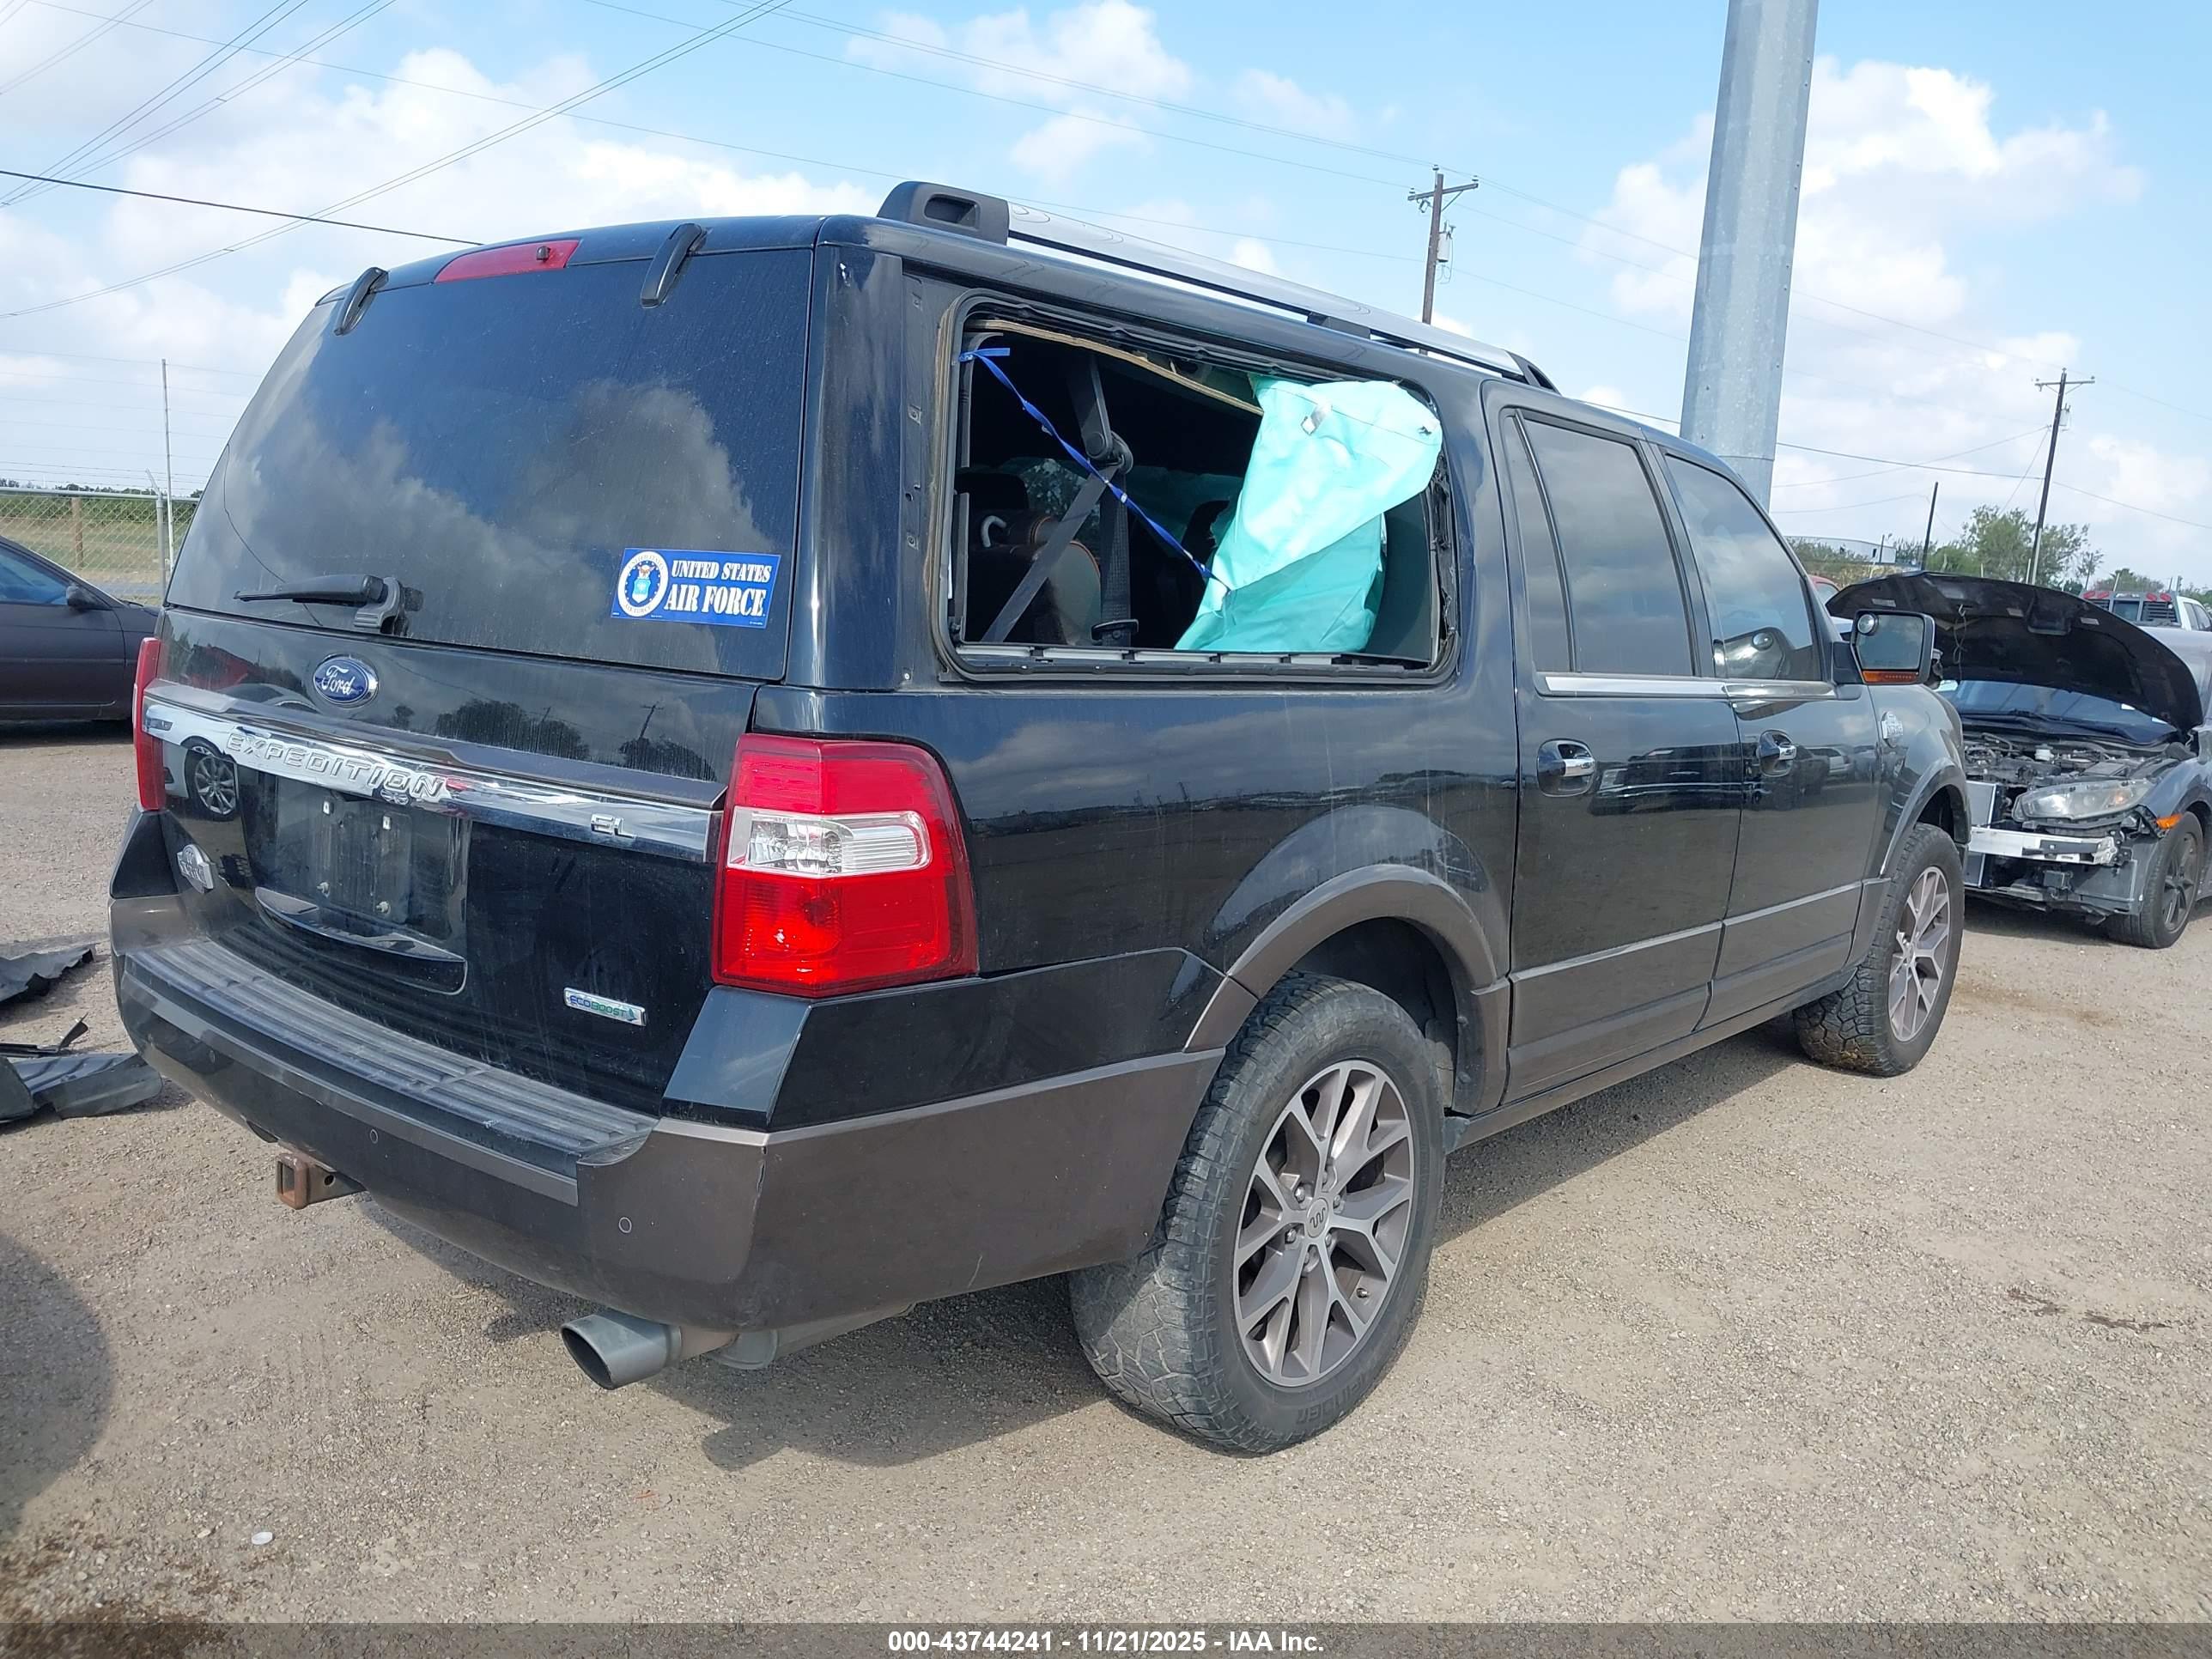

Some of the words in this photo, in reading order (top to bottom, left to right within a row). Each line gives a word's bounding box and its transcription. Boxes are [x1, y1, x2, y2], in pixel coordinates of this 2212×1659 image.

[671, 560, 720, 580] UNITED
[721, 562, 772, 583] STATES
[664, 584, 700, 612] AIR
[321, 665, 356, 696] Ford
[226, 732, 446, 799] EXPEDITION
[591, 814, 636, 839] EL
